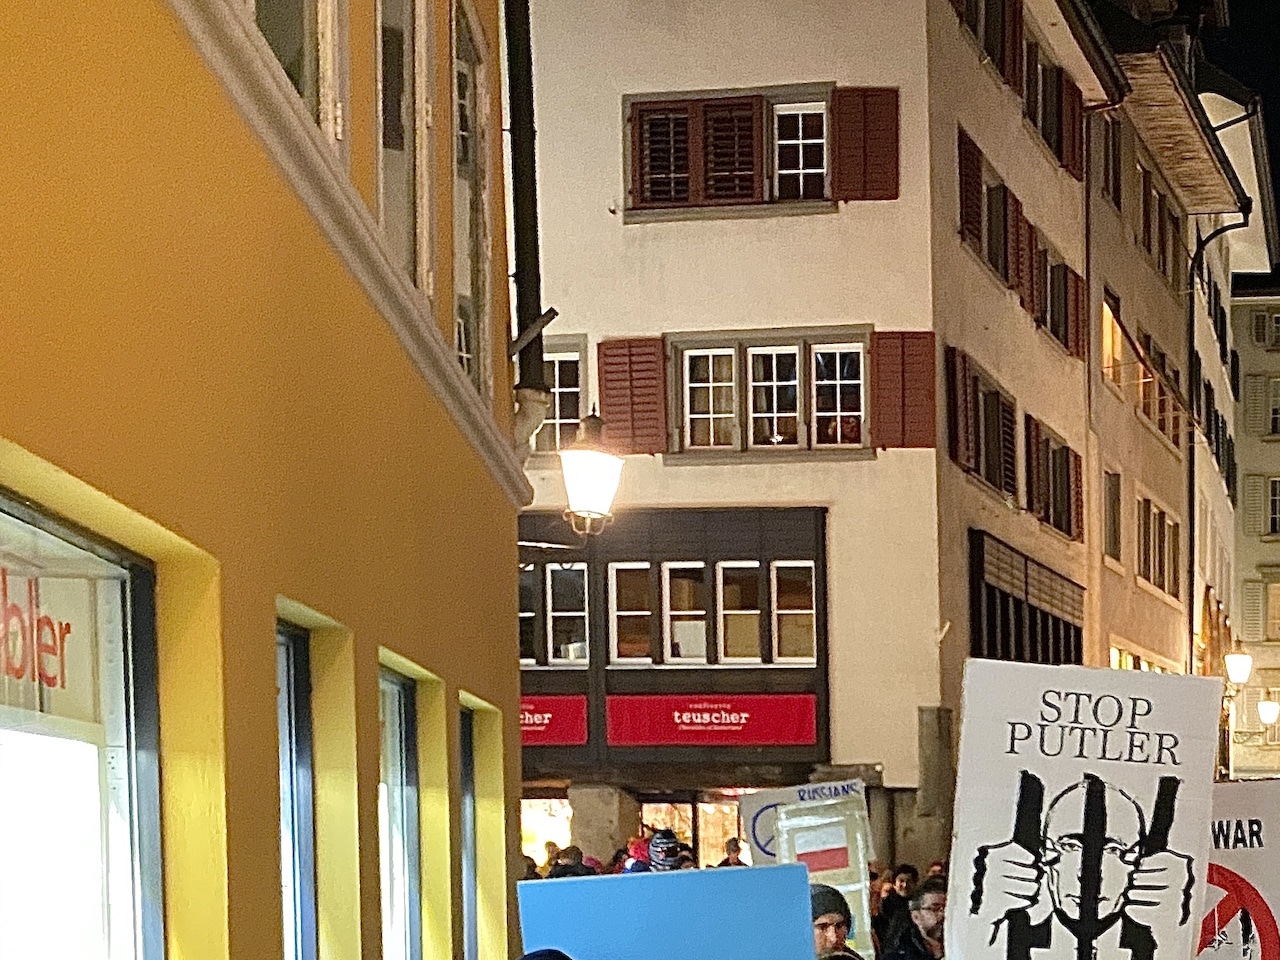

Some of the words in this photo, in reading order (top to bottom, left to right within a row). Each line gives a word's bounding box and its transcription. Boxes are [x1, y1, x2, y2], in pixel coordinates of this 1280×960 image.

[674, 710, 750, 723] teuscher
[1039, 689, 1155, 730] STOP
[1004, 721, 1183, 766] PUTLER
[1211, 818, 1265, 850] WAR
